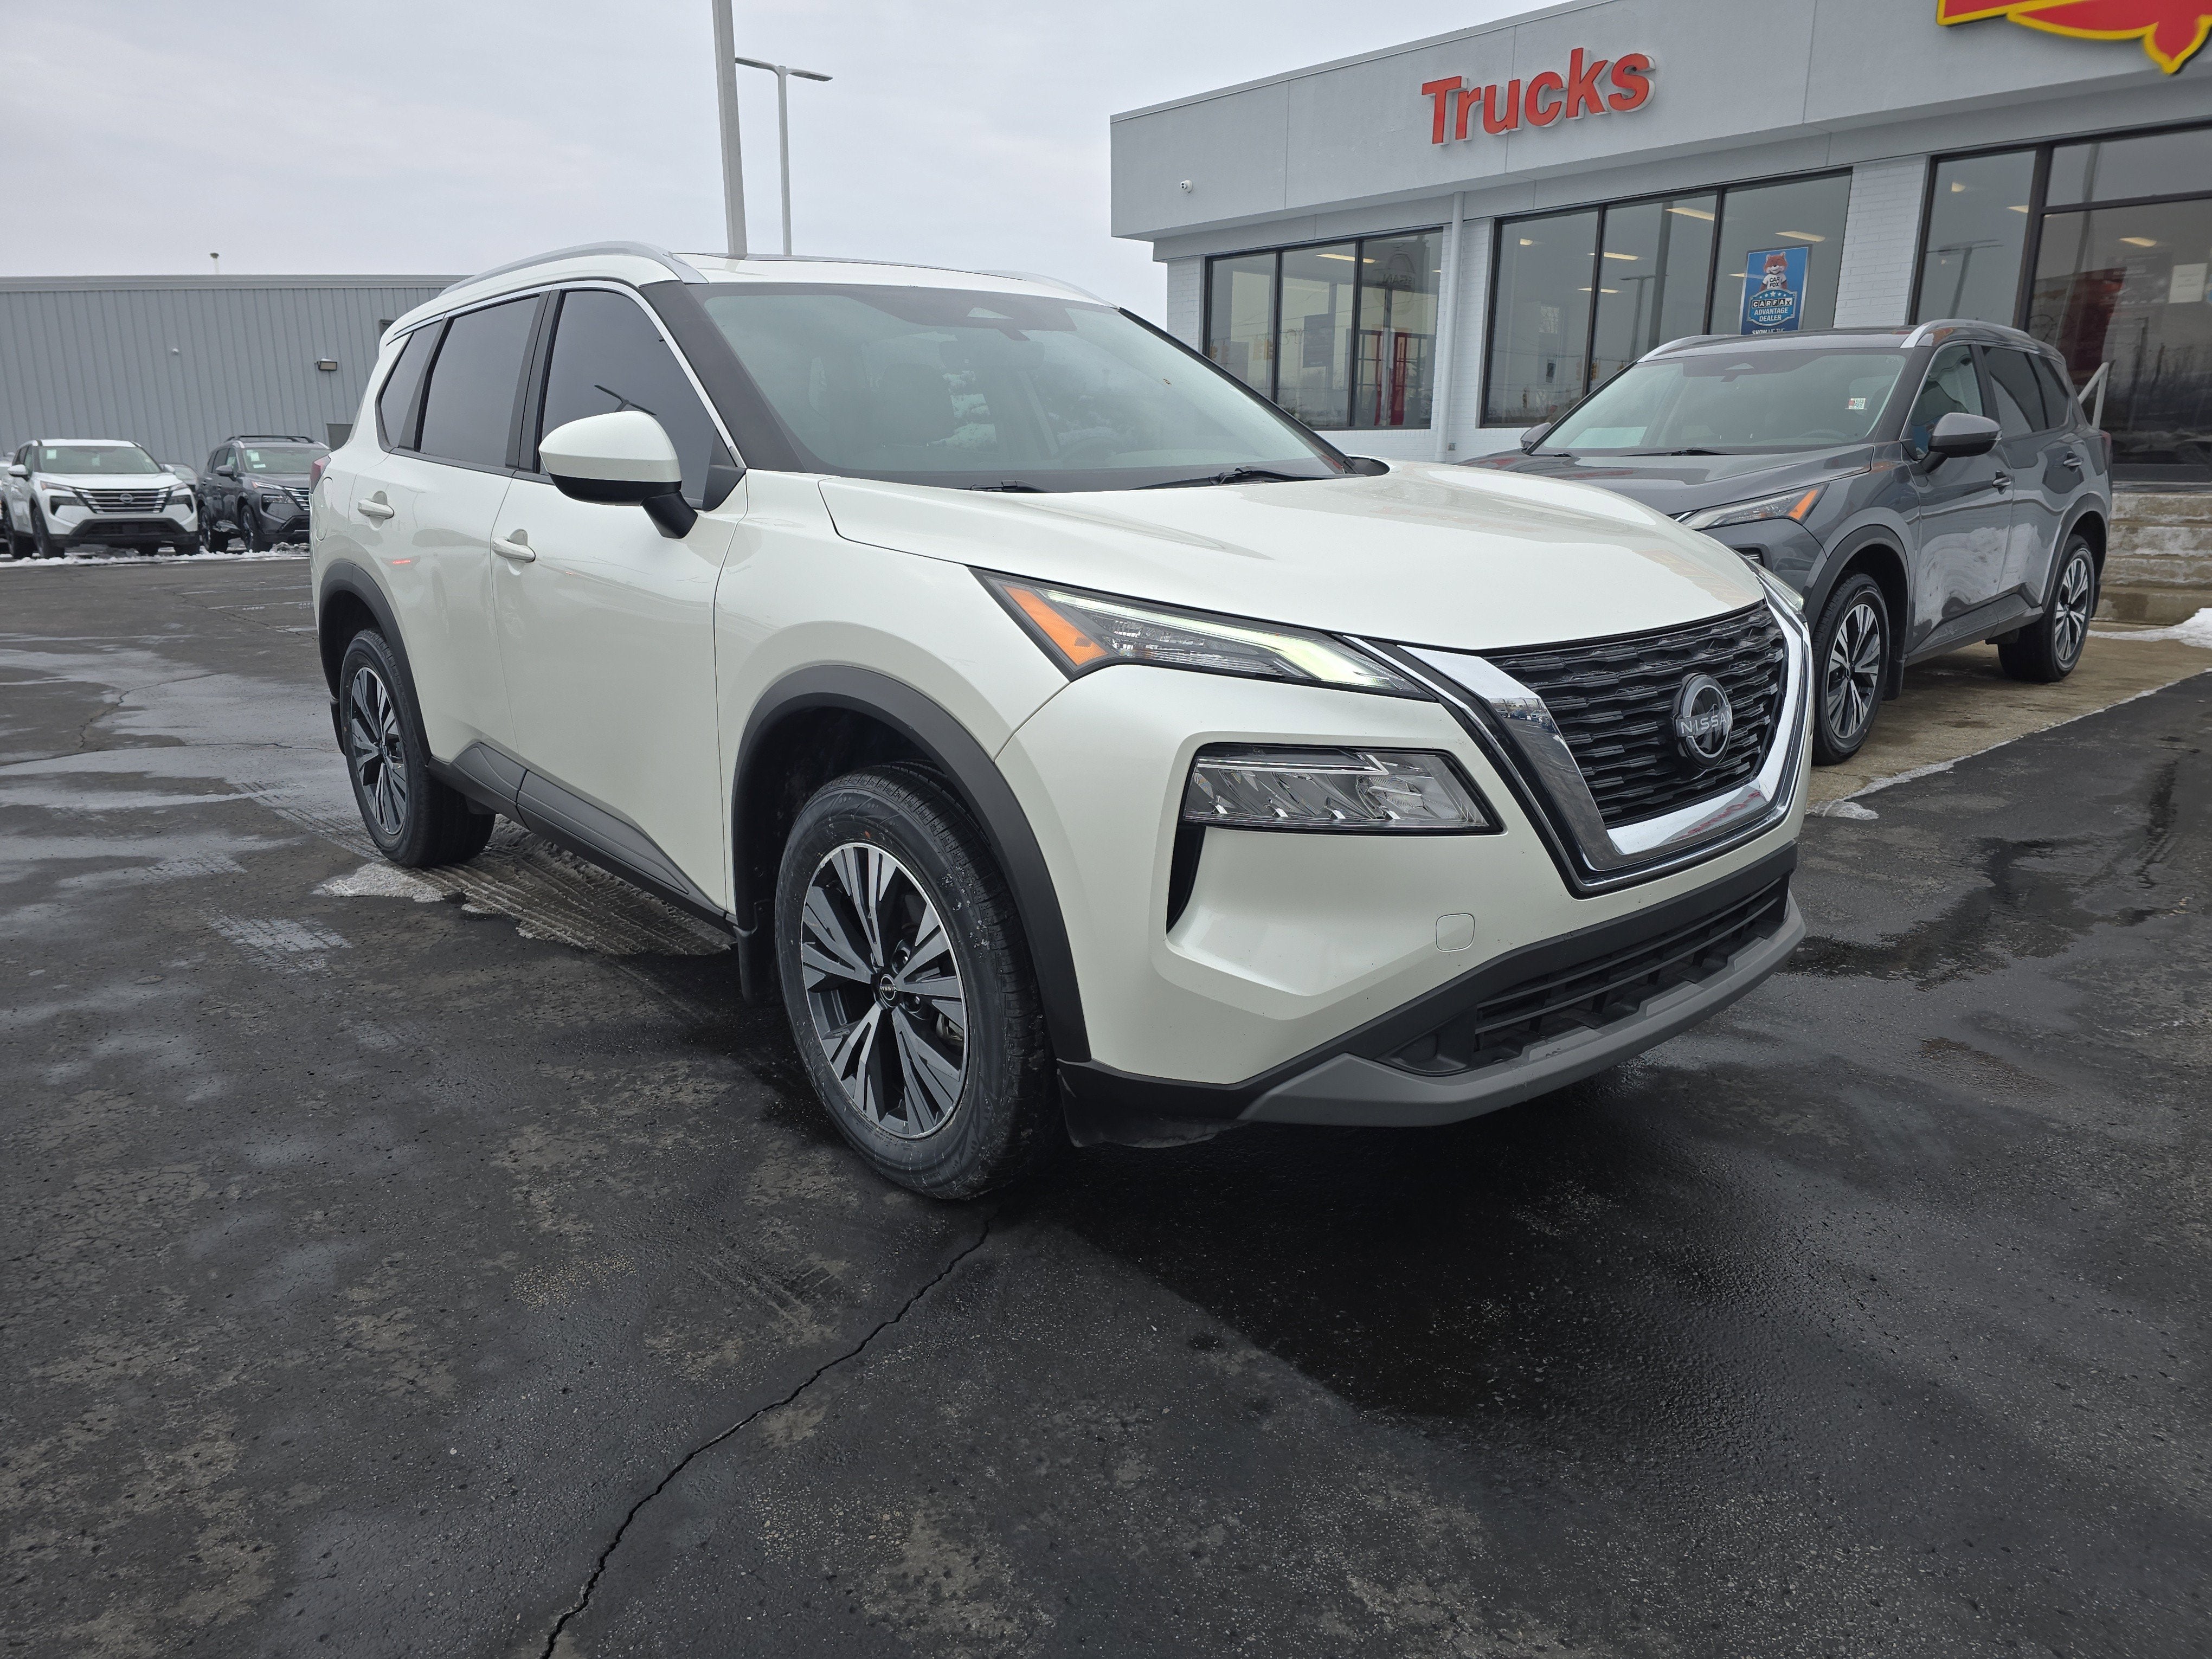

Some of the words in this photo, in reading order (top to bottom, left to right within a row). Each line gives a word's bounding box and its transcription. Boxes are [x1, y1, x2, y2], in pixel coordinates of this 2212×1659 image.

[1422, 47, 1655, 145] Trucks
[1753, 299, 1791, 307] CARFAX
[1680, 710, 1732, 734] NISSAN
